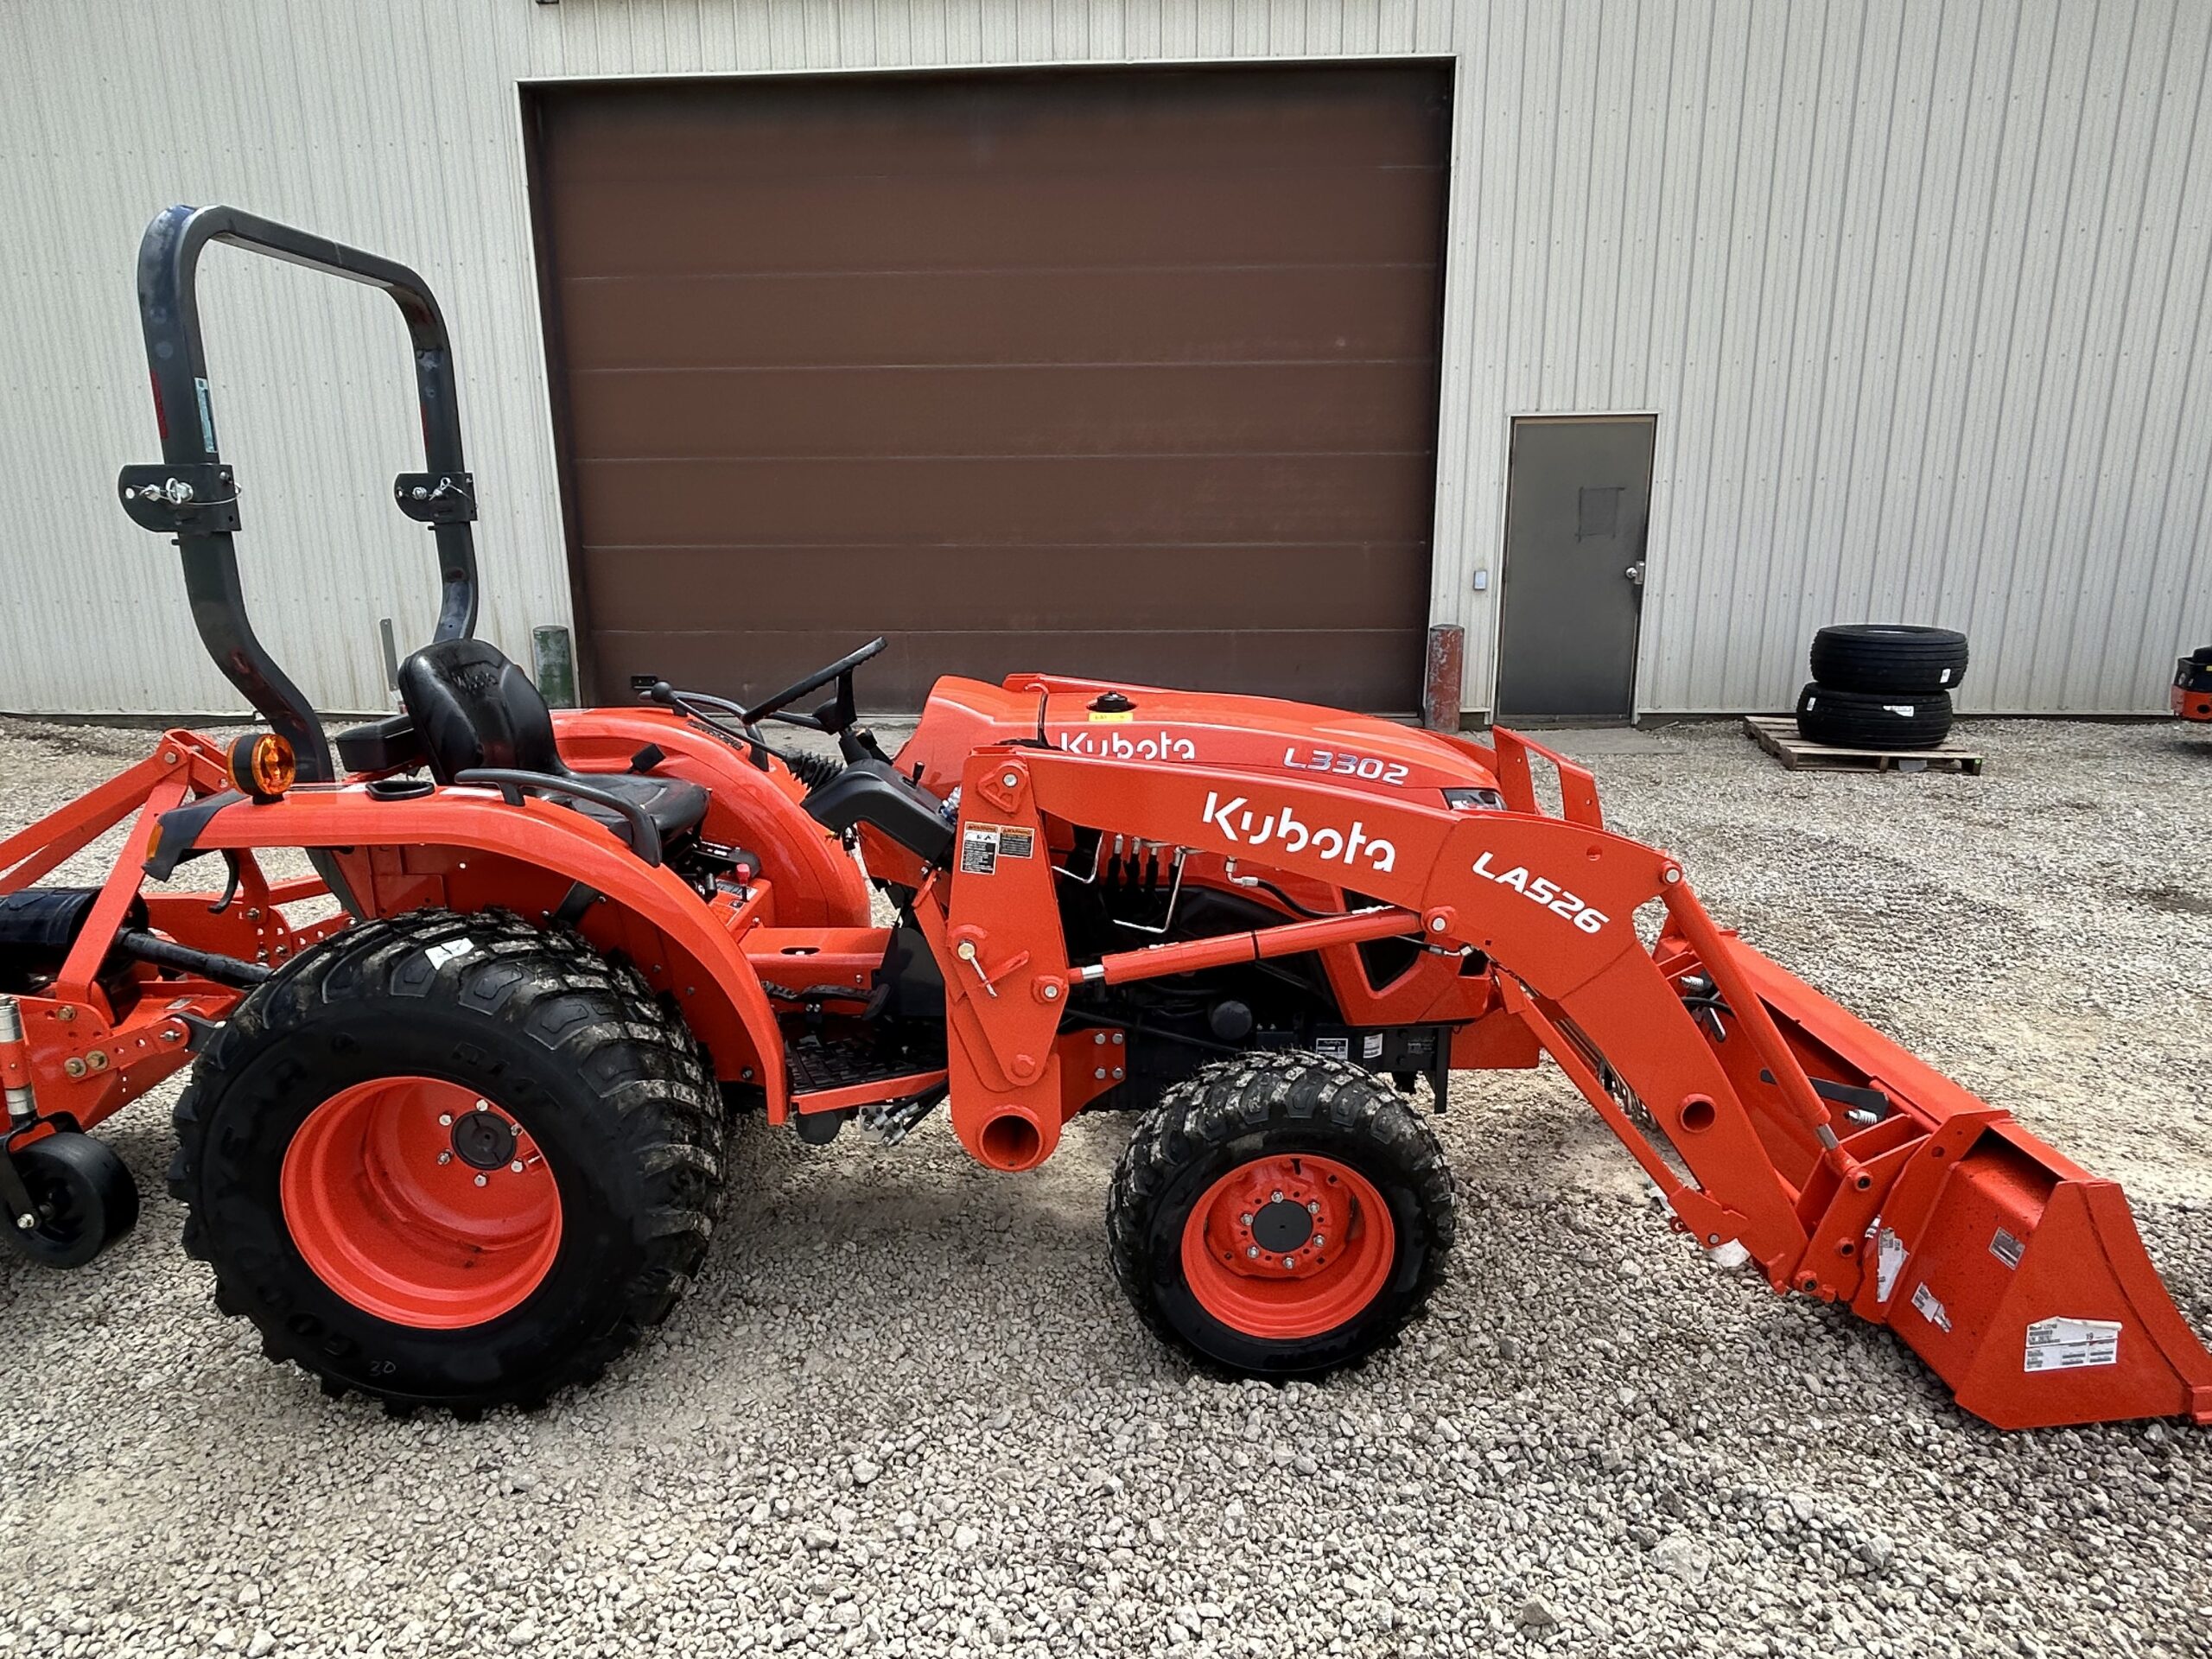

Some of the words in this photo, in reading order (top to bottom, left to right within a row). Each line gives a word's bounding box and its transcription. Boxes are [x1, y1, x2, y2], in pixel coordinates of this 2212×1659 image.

[1060, 731, 1195, 760] Kubota
[1283, 747, 1409, 785] L3302
[1202, 791, 1396, 872] Kubota
[1472, 850, 1611, 934] LA526
